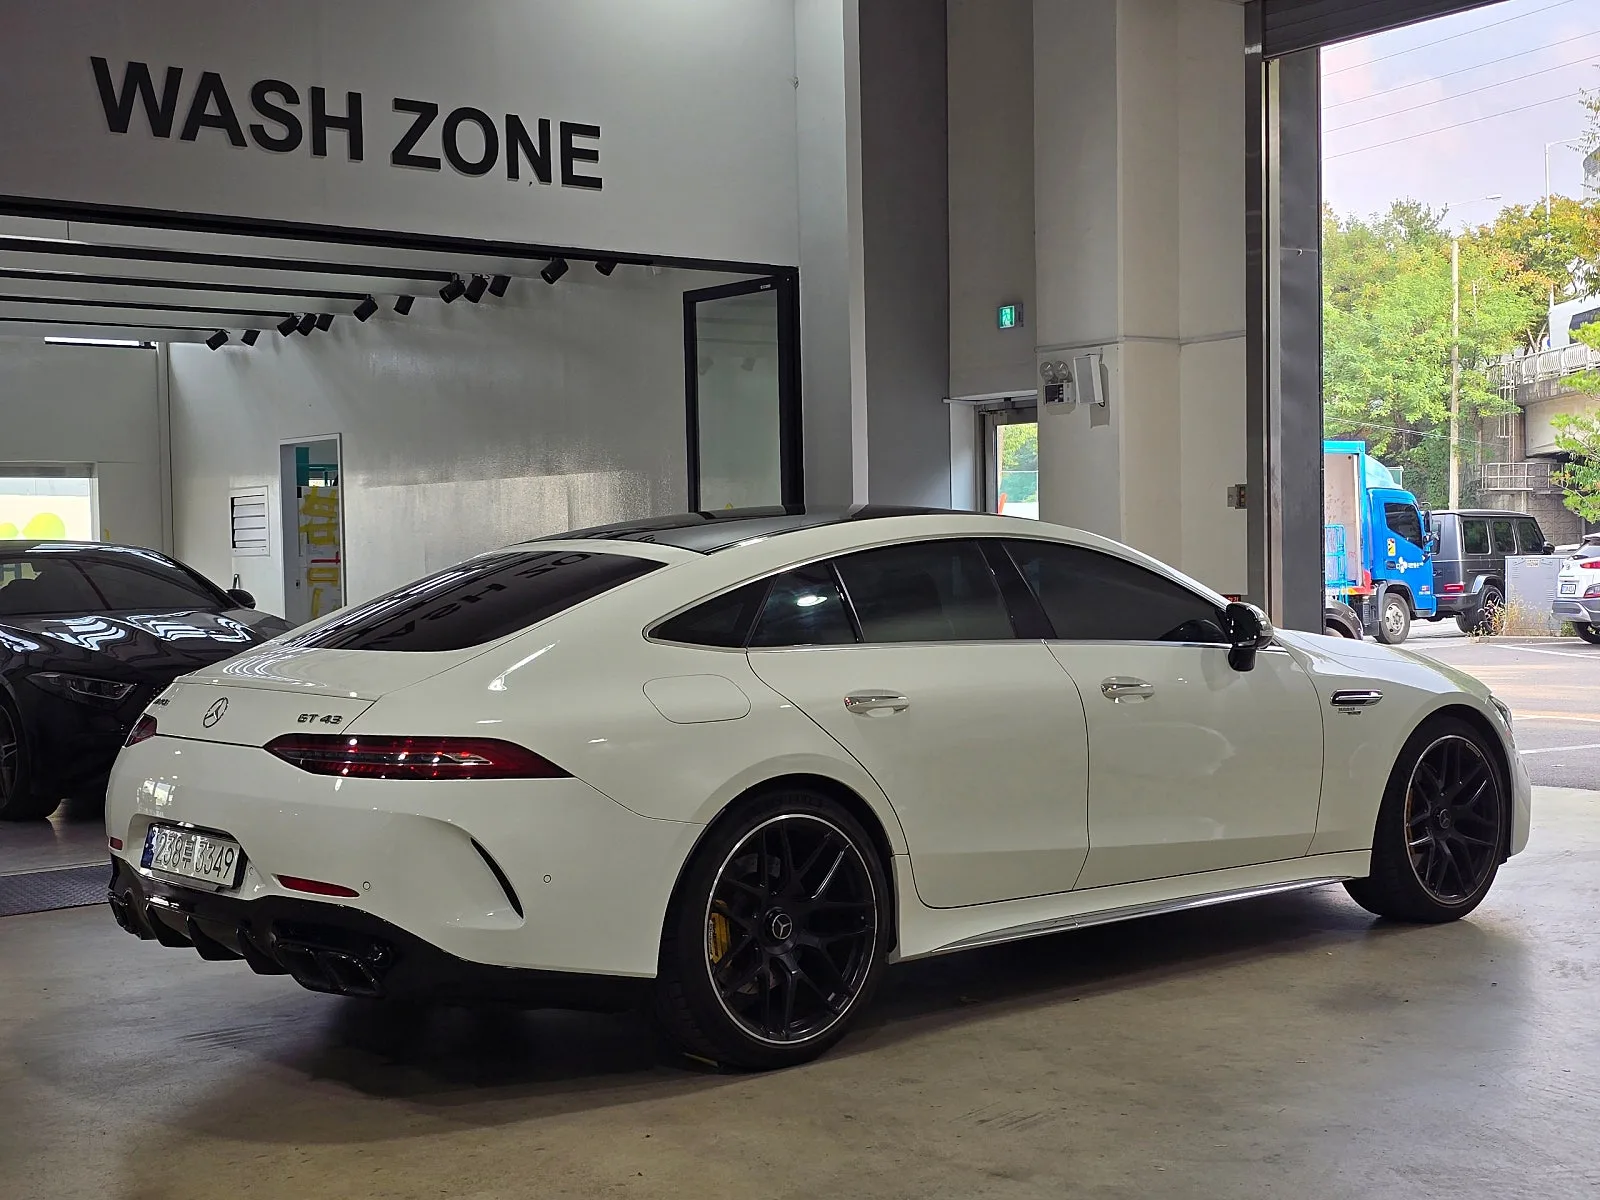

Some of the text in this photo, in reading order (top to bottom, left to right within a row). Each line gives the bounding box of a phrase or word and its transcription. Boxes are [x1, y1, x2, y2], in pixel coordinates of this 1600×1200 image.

[90, 56, 604, 192] WASH ZONE
[297, 713, 343, 724] GT 43
